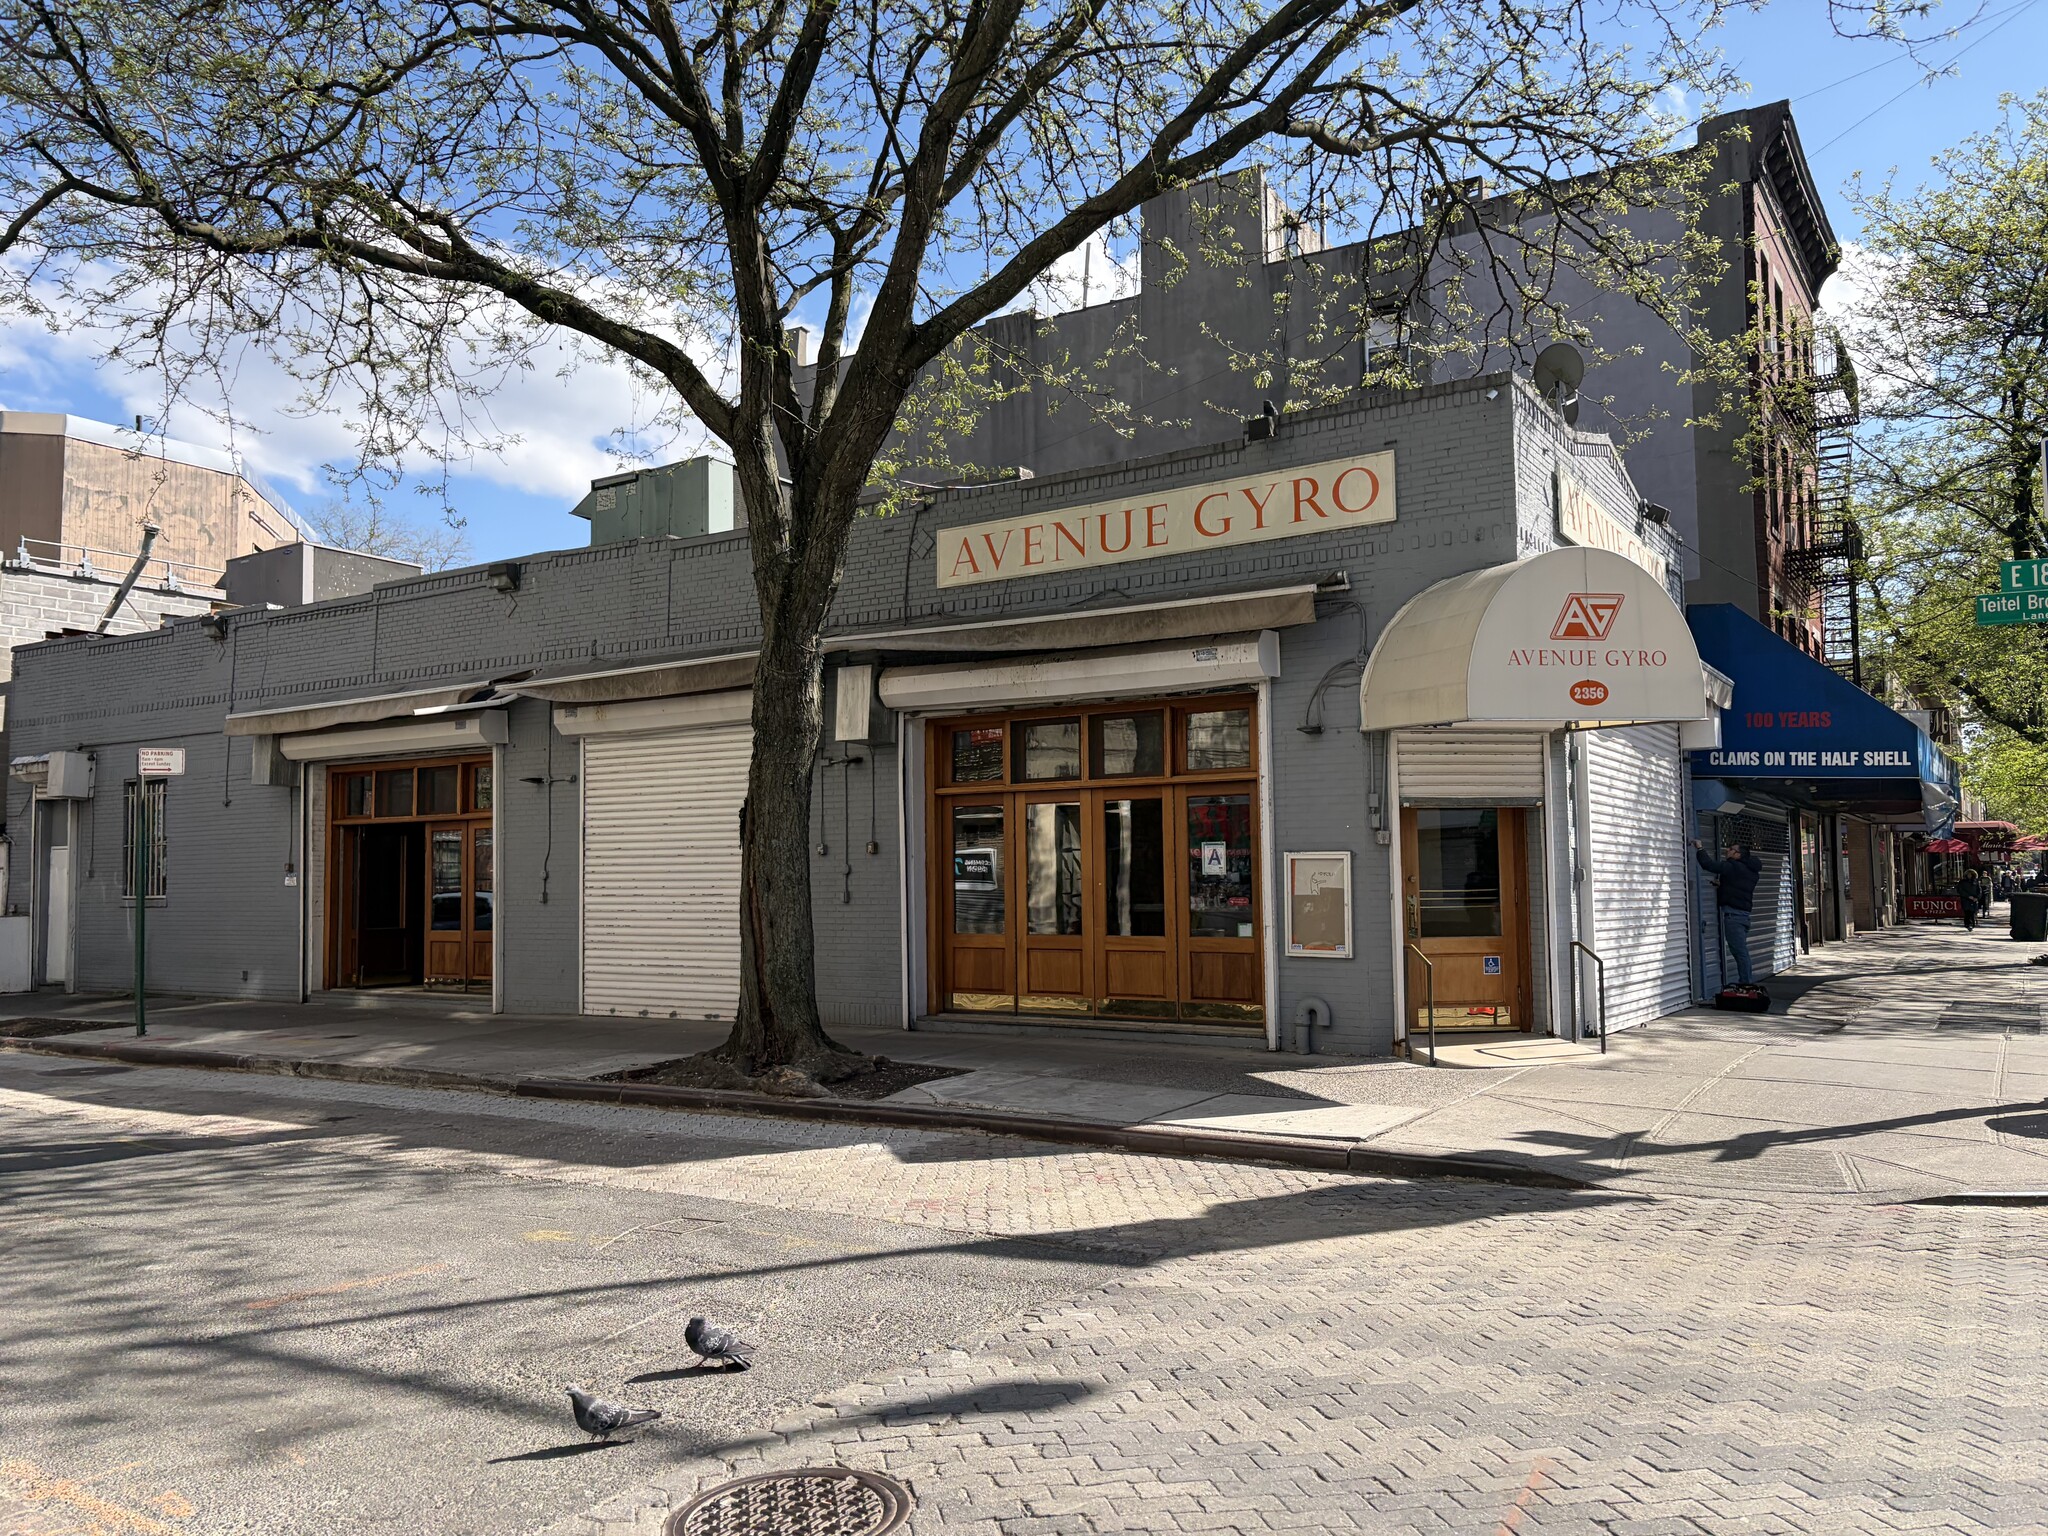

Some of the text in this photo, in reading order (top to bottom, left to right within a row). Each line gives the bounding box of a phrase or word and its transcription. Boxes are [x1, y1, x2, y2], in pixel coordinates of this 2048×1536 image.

[950, 467, 1380, 578] AVENUE GYRO
[2011, 565, 2023, 587] E
[1980, 596, 2020, 612] Teitel
[1507, 650, 1667, 667] AVENUE GYRO
[1573, 686, 1605, 700] 2356
[1745, 711, 1832, 728] 100 YEARS
[1709, 751, 1912, 766] CLAMS ON THE HALF SHELL
[1208, 848, 1222, 866] A
[1913, 900, 1958, 911] FUNICI
